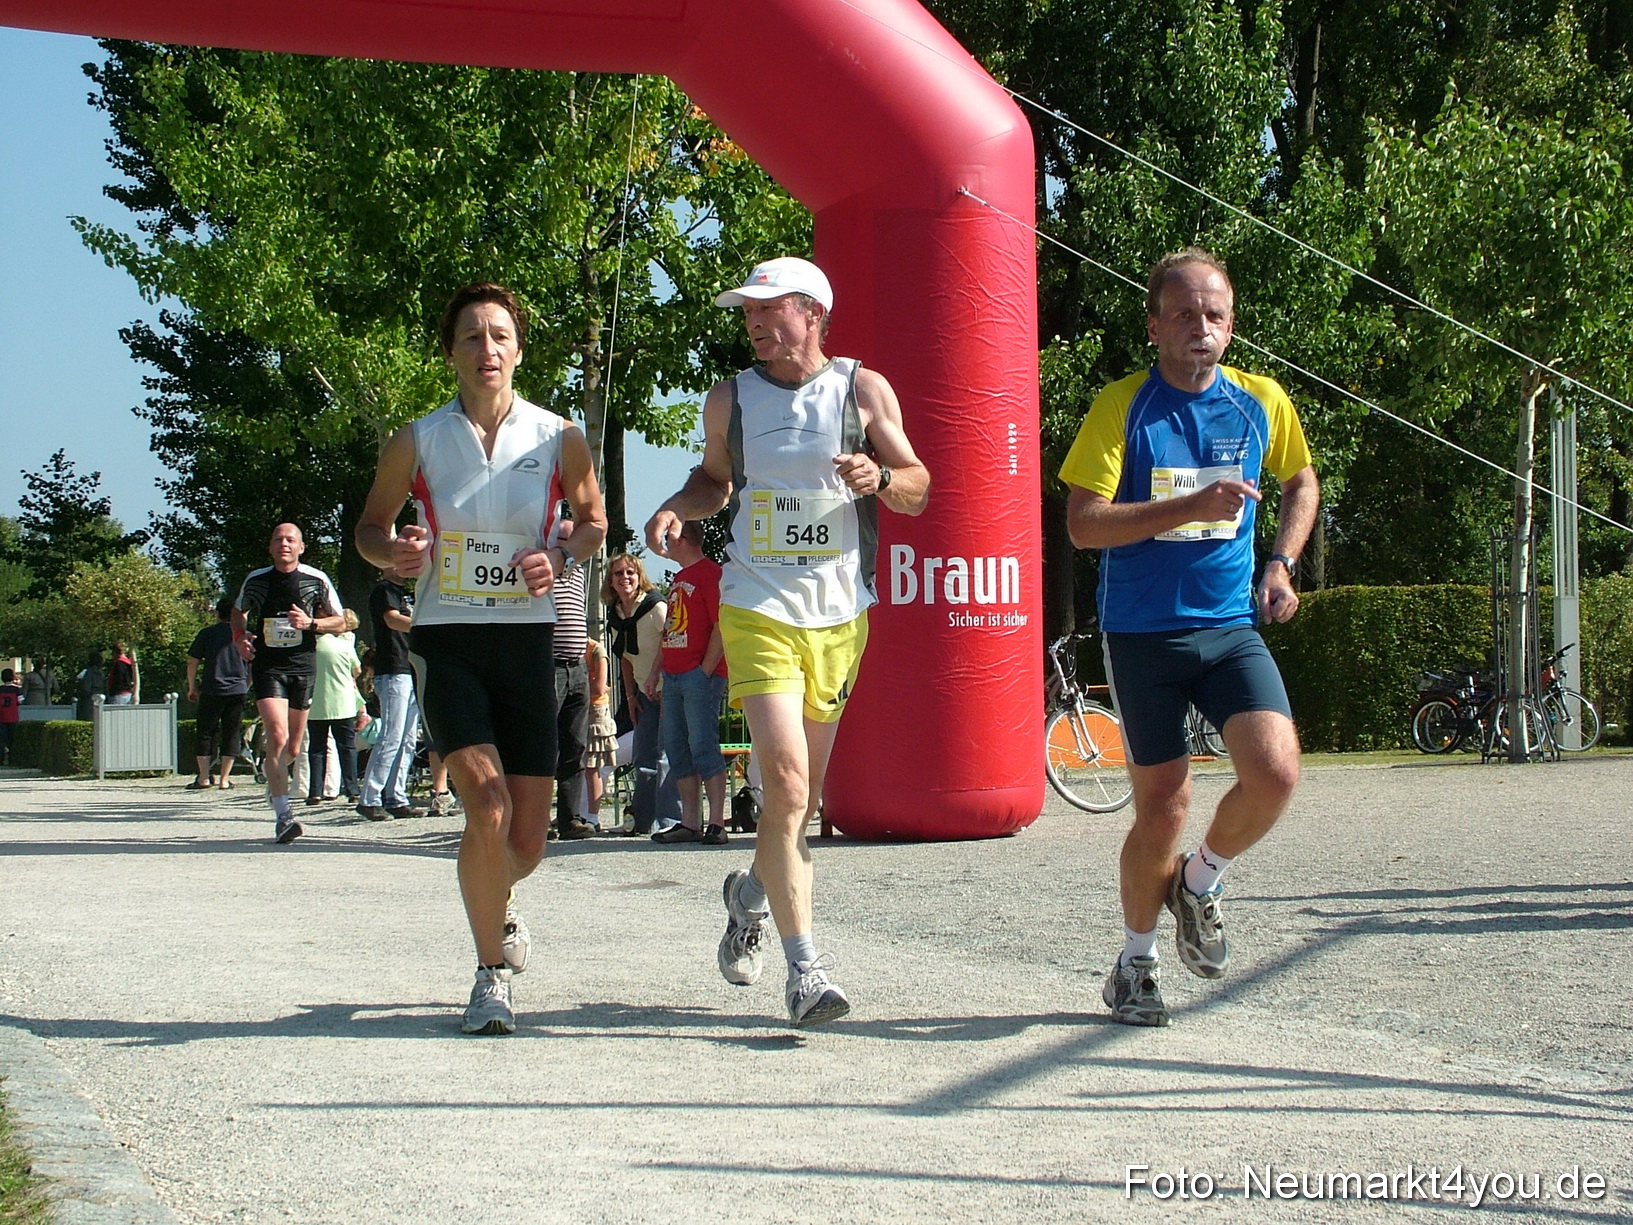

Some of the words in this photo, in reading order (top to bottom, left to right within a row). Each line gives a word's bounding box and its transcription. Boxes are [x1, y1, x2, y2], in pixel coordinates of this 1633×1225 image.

[1007, 422, 1018, 450] 1929
[1008, 454, 1018, 475] Seit
[1174, 474, 1196, 489] Willi
[775, 496, 801, 512] Willi
[754, 519, 761, 531] B
[785, 524, 829, 546] 548
[466, 537, 500, 554] Petra
[445, 557, 451, 568] C
[474, 565, 518, 587] 994
[889, 544, 1020, 605] Braun
[948, 610, 985, 627] Sicher
[988, 611, 1001, 627] ist
[1003, 610, 1028, 626] sicher
[277, 631, 296, 639] 742
